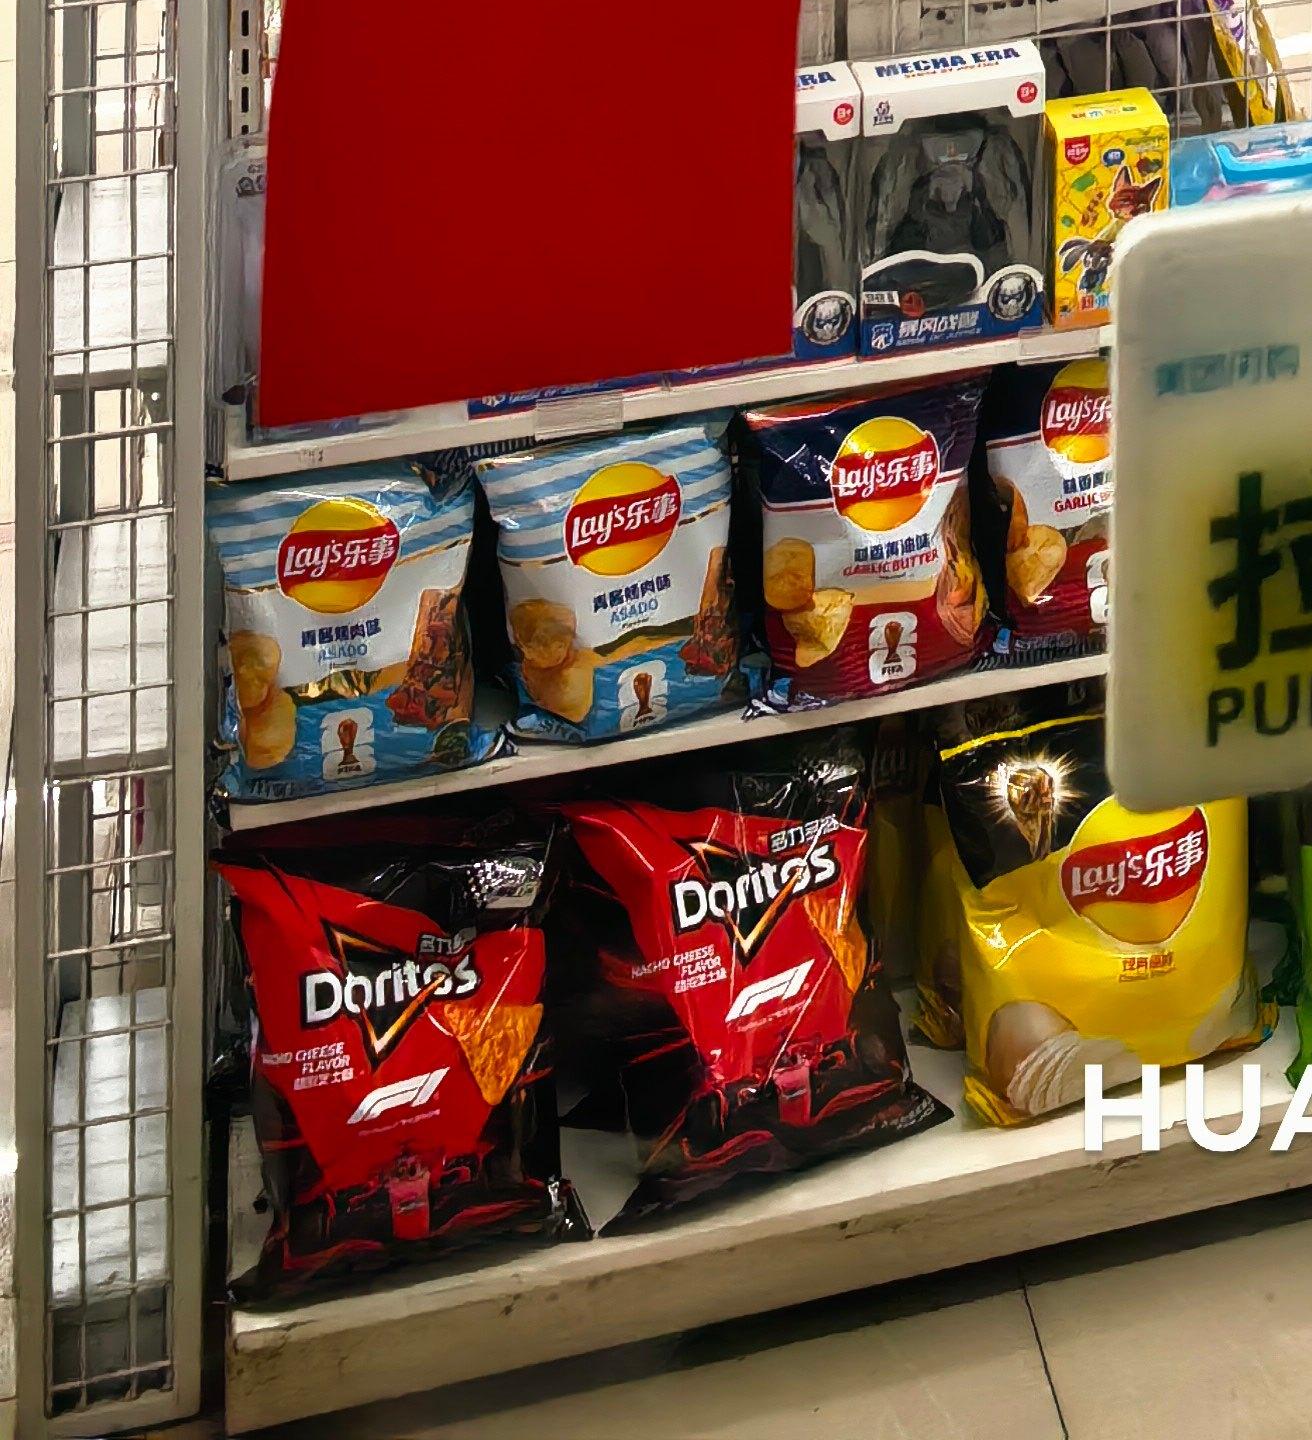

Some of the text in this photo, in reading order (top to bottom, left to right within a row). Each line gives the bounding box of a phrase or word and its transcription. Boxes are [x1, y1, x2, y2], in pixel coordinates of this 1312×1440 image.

[797, 71, 837, 88] RA
[874, 46, 1022, 79] MECHA ERA
[1045, 395, 1094, 432] Lay's
[836, 449, 937, 498] Lay's 乐事
[1054, 491, 1099, 514] GARLIC
[571, 504, 626, 548] Lay's
[283, 532, 399, 578] Lay's 乐事
[1069, 828, 1206, 898] Lay's 乐事
[673, 843, 837, 930] Doritos
[673, 943, 716, 966] CHEESE
[680, 955, 723, 978] FLAVOR
[304, 954, 480, 1025] Doritos
[294, 1041, 346, 1062] CHEESE
[301, 1054, 351, 1075] FLAVOR
